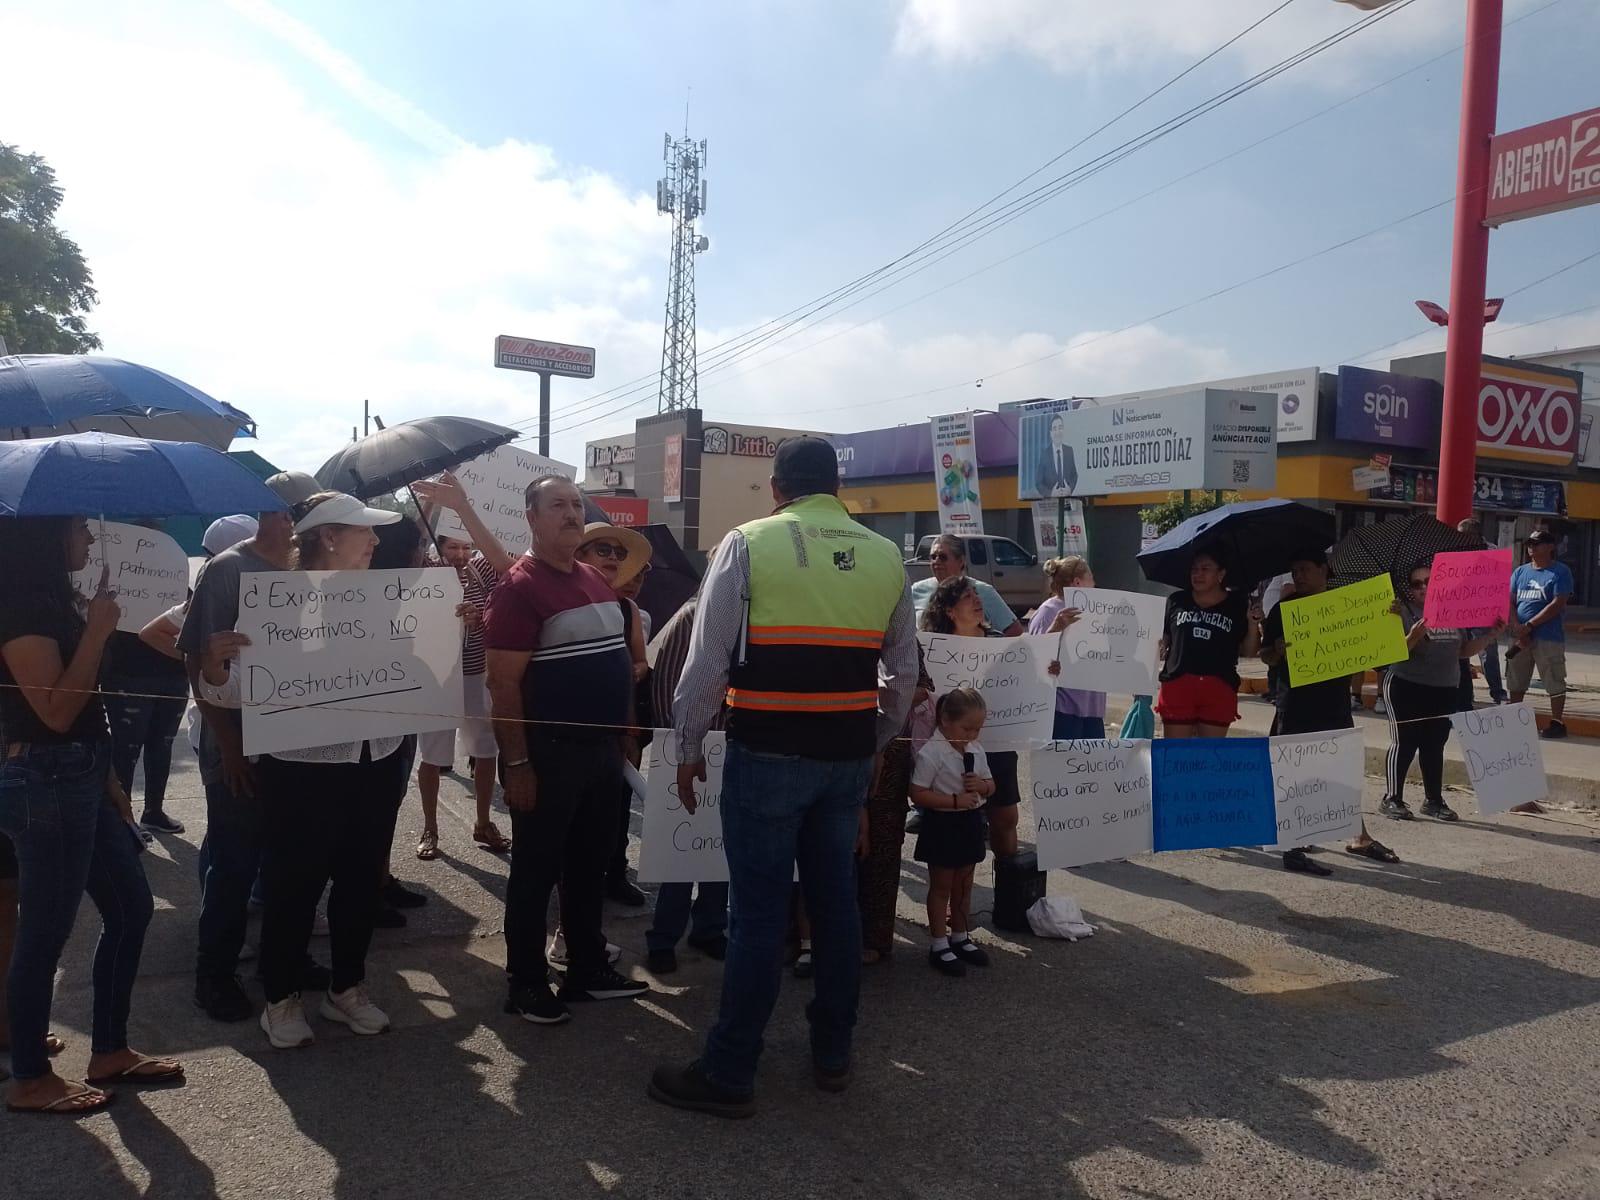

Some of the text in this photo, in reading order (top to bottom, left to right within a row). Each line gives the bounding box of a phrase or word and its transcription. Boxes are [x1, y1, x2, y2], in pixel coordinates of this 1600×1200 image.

[1492, 136, 1567, 199] ABIERTO
[523, 342, 592, 363] AutoZone
[503, 354, 546, 367] REFACCIONES
[554, 361, 591, 373] ACCESORIOS
[1363, 388, 1409, 424] spin
[1477, 384, 1575, 446] OXXO
[1087, 427, 1173, 445] SINALOA SE INFORMA CON
[1211, 432, 1271, 444] ANÚNCIATE AQUÍ
[1238, 424, 1271, 433] DISPONIBLE
[731, 434, 776, 457] Little
[836, 446, 854, 461] pin
[1086, 431, 1192, 470] LUIS ALBERTO DÍAZ
[497, 479, 526, 493] Lucha
[482, 500, 495, 513] al
[606, 512, 634, 523] AUTO
[136, 538, 156, 554] por
[384, 576, 446, 602] obras
[1072, 590, 1136, 616] Queremos
[1316, 605, 1336, 619] MAS
[390, 614, 418, 637] NO
[1090, 620, 1150, 640] Solución del
[1176, 610, 1233, 633] LOS ANGELES
[247, 661, 418, 707] Destructivas.
[944, 673, 1019, 690] Solución
[1271, 737, 1338, 768] xigimos
[1066, 756, 1125, 774] Solución
[1033, 781, 1069, 800] Cada
[1075, 782, 1100, 795] año
[1276, 776, 1328, 803] Solución
[1037, 817, 1090, 833] Alarcon
[672, 821, 724, 852] Cana
